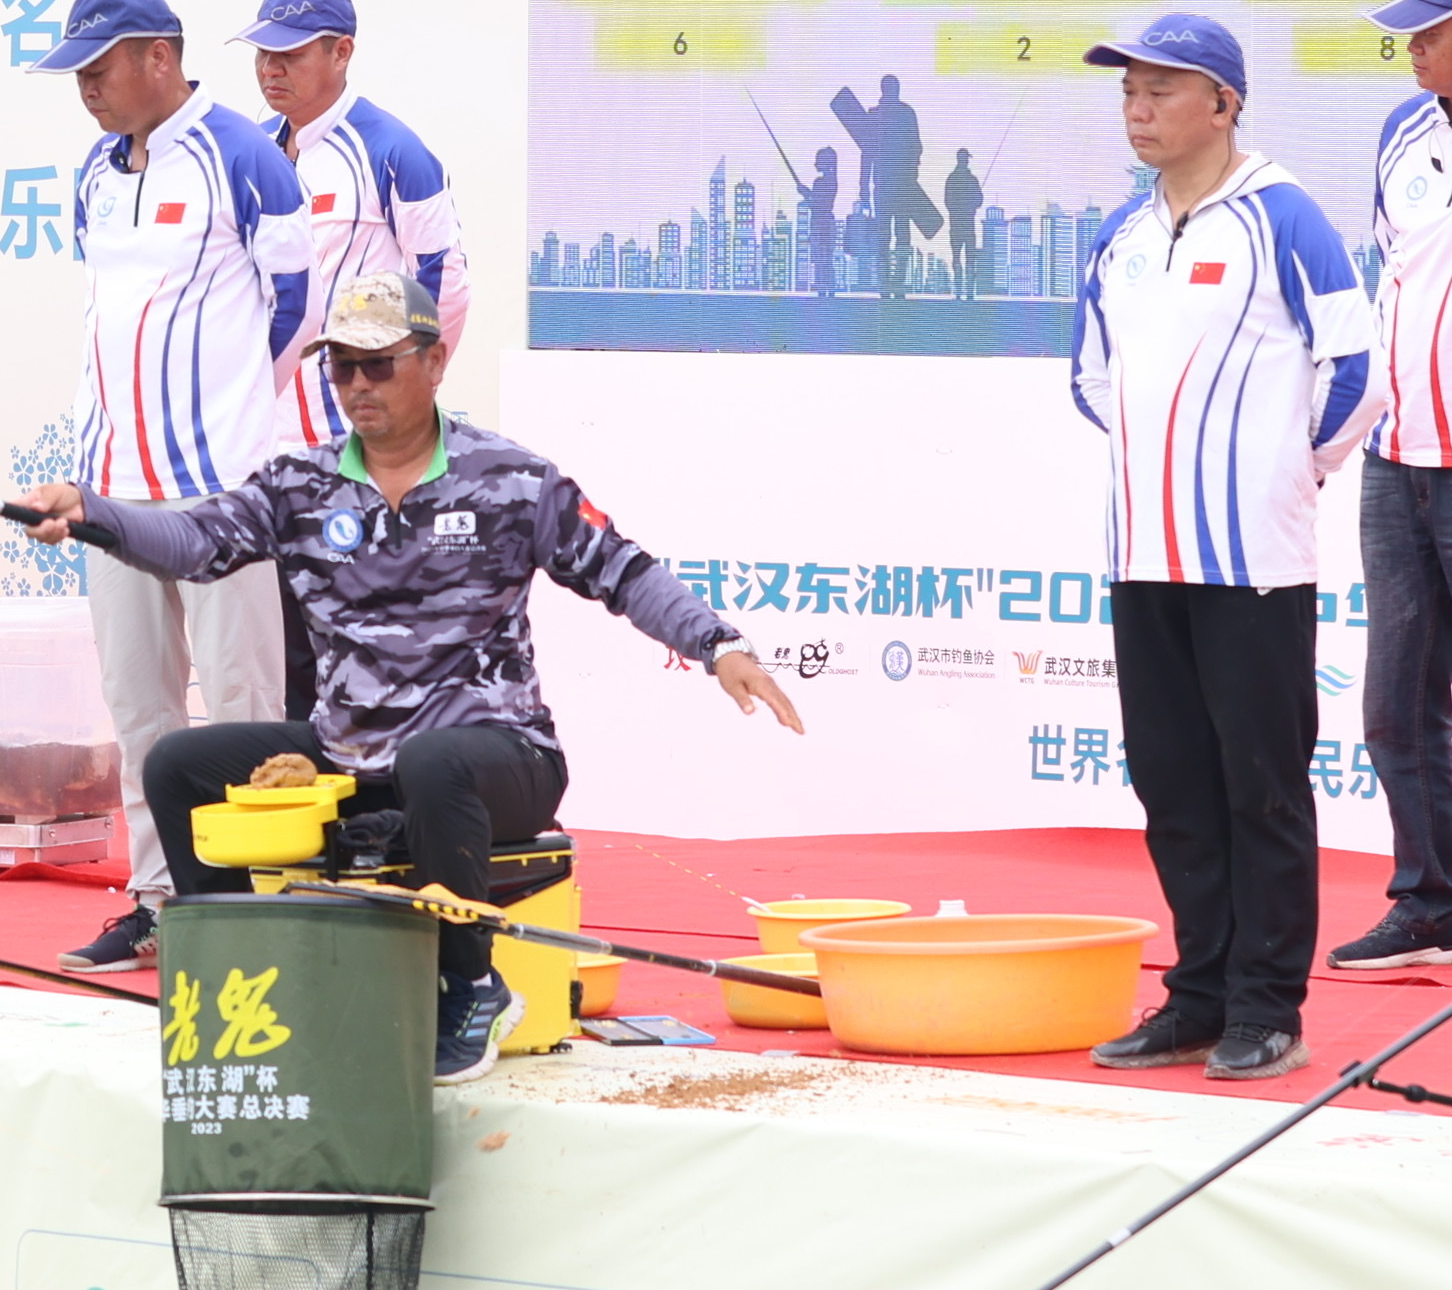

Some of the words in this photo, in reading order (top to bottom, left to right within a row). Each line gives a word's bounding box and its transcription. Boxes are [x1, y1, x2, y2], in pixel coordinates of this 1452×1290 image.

[270, 0, 317, 21] CAA
[673, 33, 688, 56] 6
[1143, 28, 1198, 46] CAA
[1016, 37, 1031, 60] 2
[1379, 36, 1396, 61] 8
[918, 648, 994, 665] 武汉市钓鱼协会
